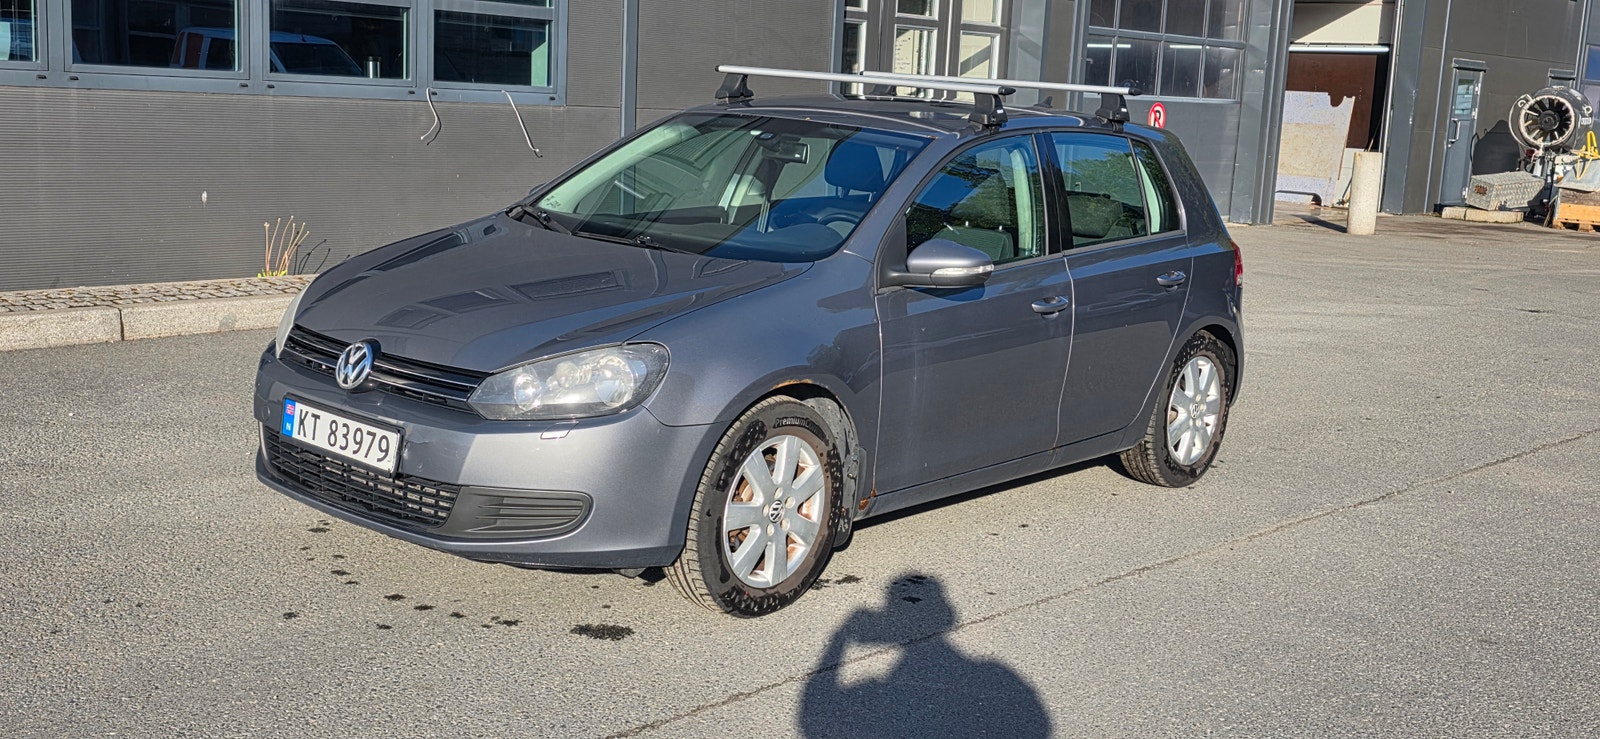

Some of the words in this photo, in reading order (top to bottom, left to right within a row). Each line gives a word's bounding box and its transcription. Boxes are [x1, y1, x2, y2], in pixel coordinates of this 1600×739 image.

[285, 422, 291, 431] N
[297, 408, 320, 441] KT
[327, 419, 390, 463] 83979
